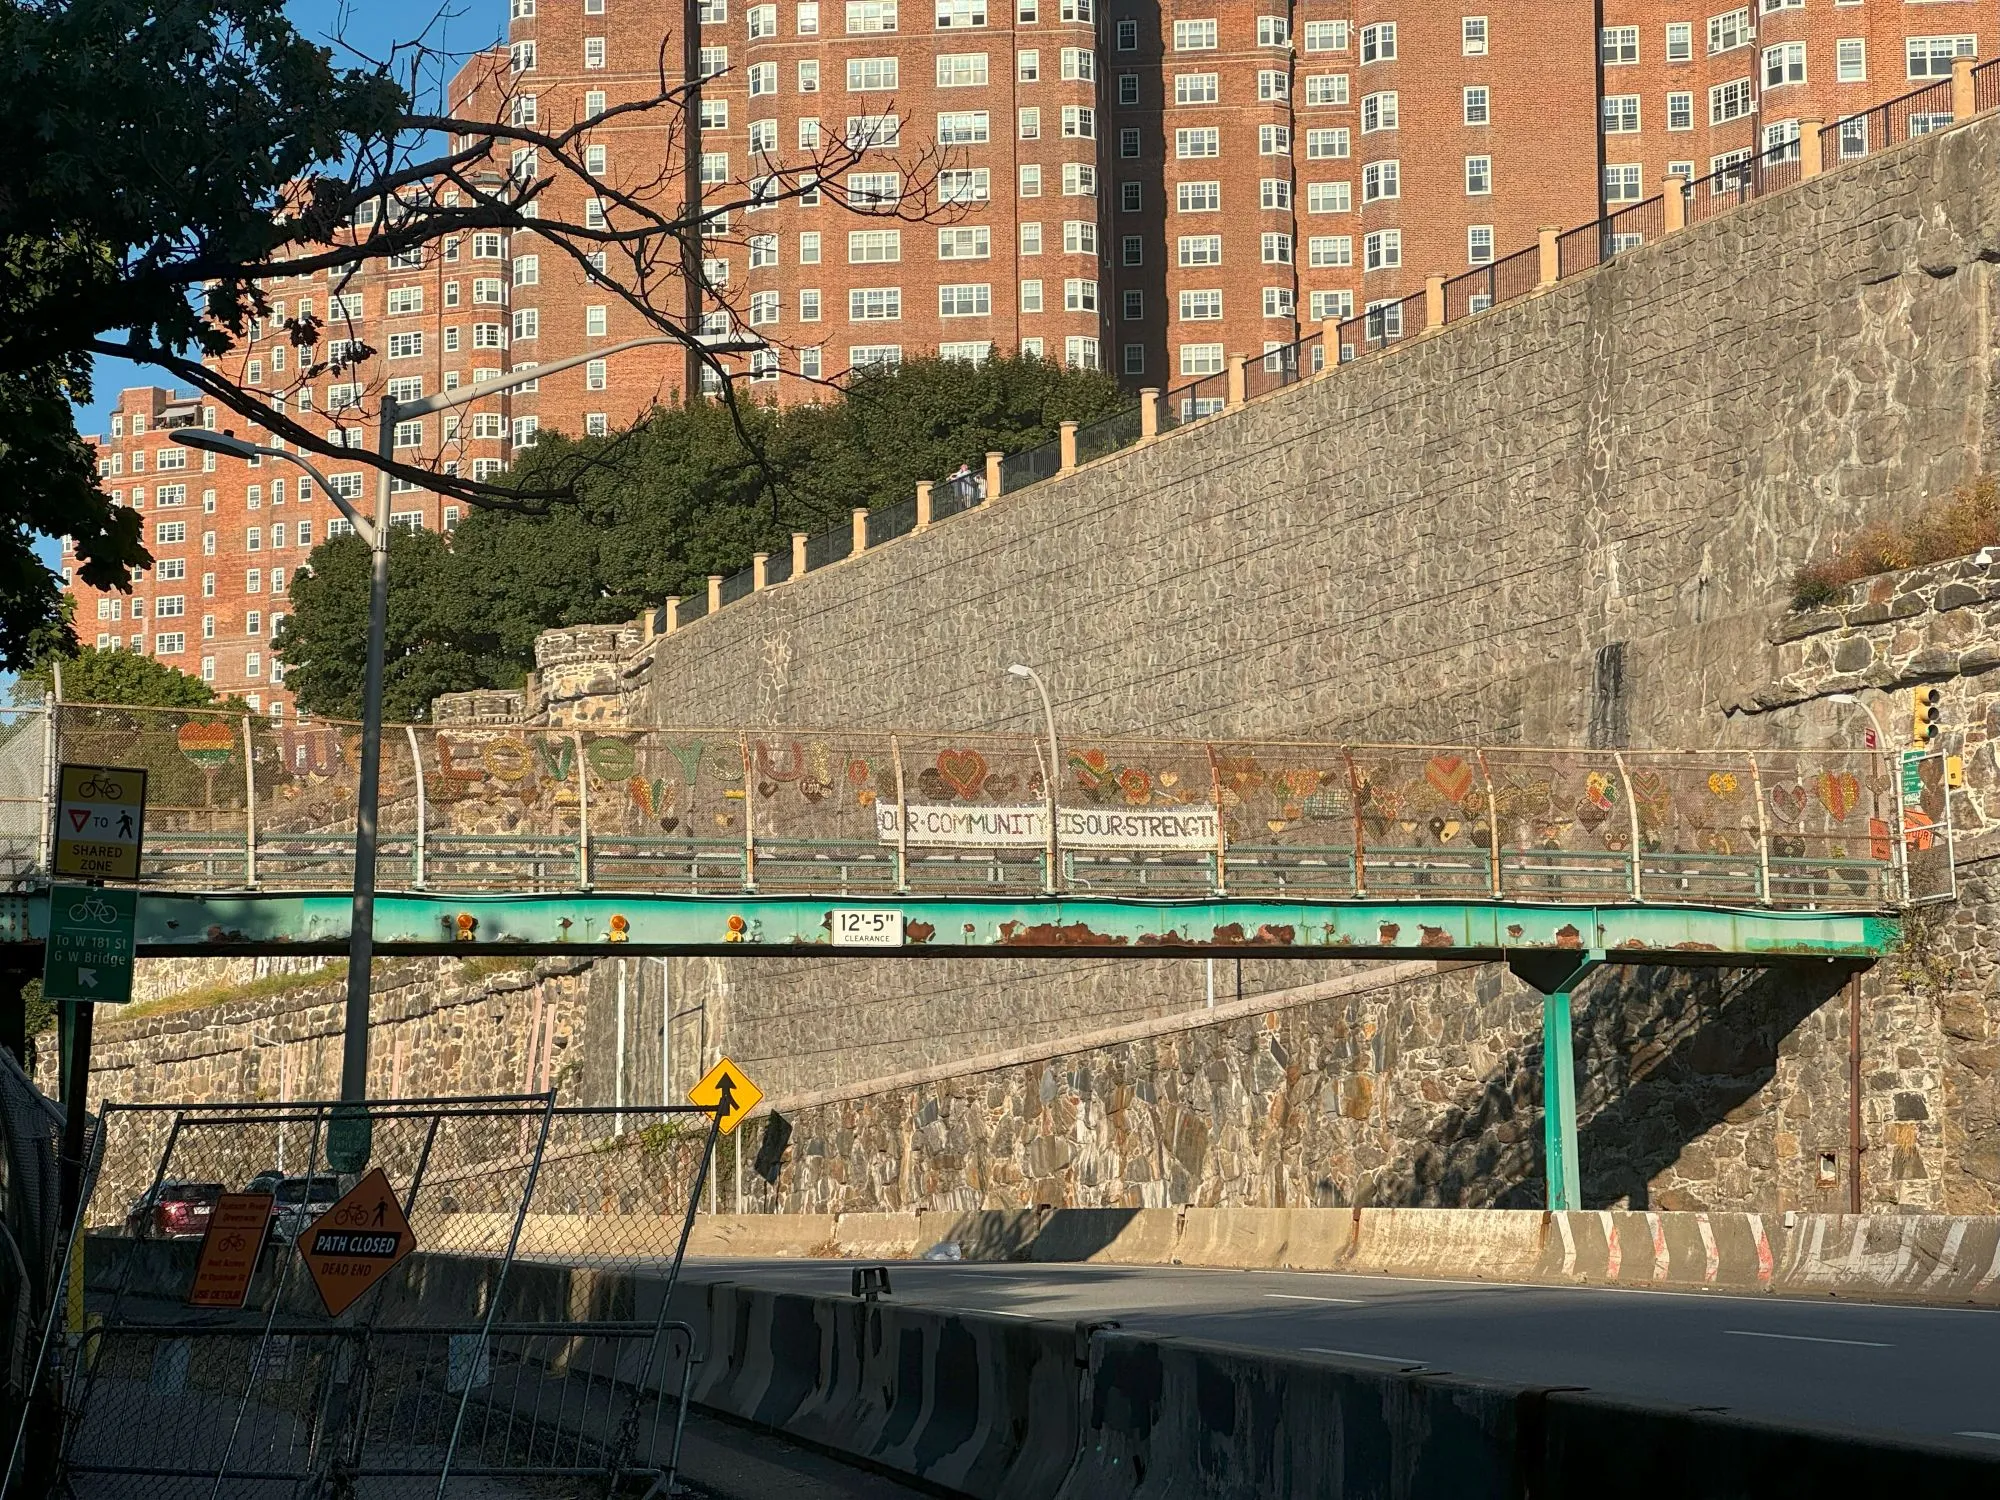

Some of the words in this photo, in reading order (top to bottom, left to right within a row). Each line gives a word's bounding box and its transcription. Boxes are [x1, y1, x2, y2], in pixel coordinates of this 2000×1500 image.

[93, 816, 109, 829] TO
[927, 812, 1048, 836] COMMUNITY
[1058, 813, 1084, 835] IS
[1086, 814, 1123, 837] OUR
[72, 844, 123, 858] SHARED
[80, 859, 113, 872] ZONE
[841, 913, 894, 932] 12'-5"
[55, 934, 69, 946] To
[75, 936, 87, 947] W
[92, 938, 110, 949] 181
[114, 938, 127, 950] St
[844, 935, 890, 943] CLEARANCE
[54, 950, 62, 962] G
[68, 951, 80, 962] W
[84, 950, 126, 968] Bridge
[315, 1235, 346, 1252] PATH
[349, 1236, 396, 1254] CLOSED
[321, 1262, 349, 1276] DEAD
[350, 1263, 372, 1277] END
